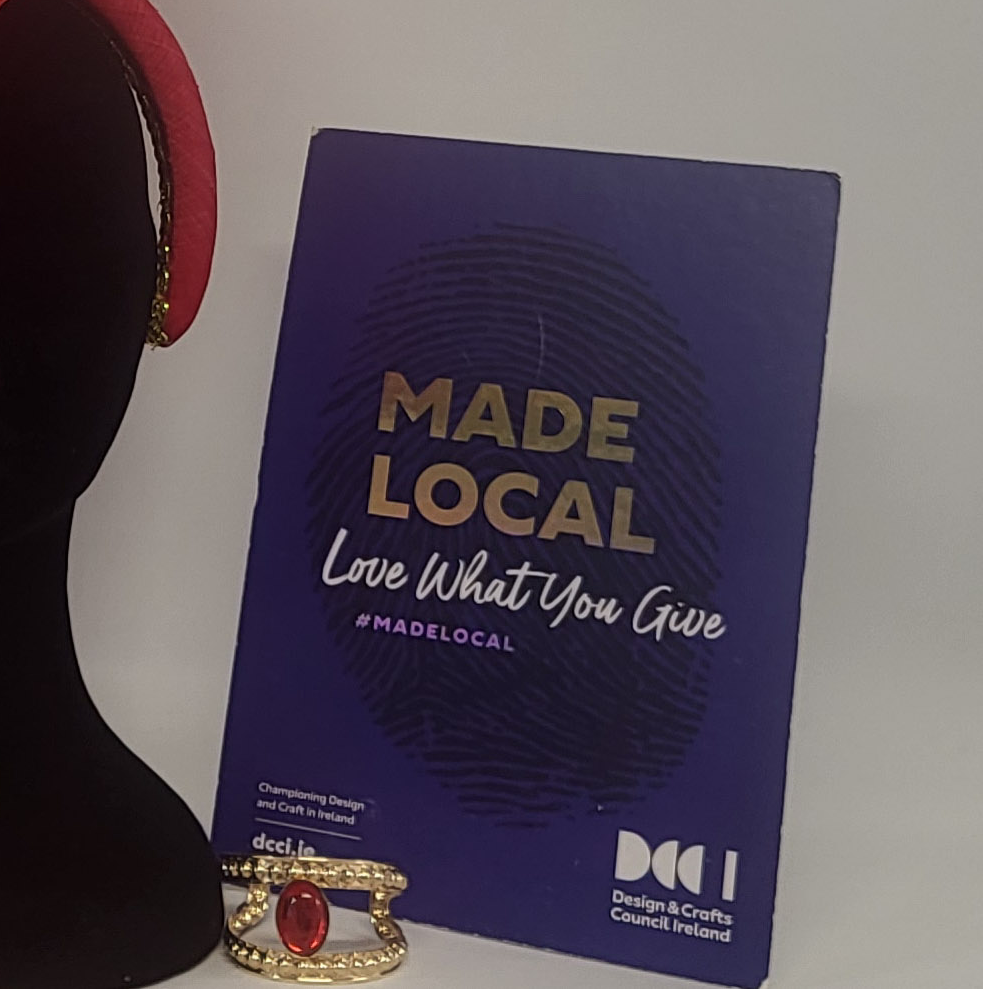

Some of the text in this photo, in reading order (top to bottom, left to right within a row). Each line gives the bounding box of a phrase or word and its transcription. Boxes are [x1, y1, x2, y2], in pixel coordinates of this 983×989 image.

[377, 370, 639, 463] MADE
[367, 454, 656, 555] LOCAL
[321, 527, 727, 641] Love What You Give
[355, 612, 515, 652] #MADELOCAL
[256, 798, 355, 825] and Craft in Ireland
[257, 781, 365, 812] Championing Design
[610, 907, 732, 943] Council Ireland
[612, 889, 734, 926] Design & Crafts
